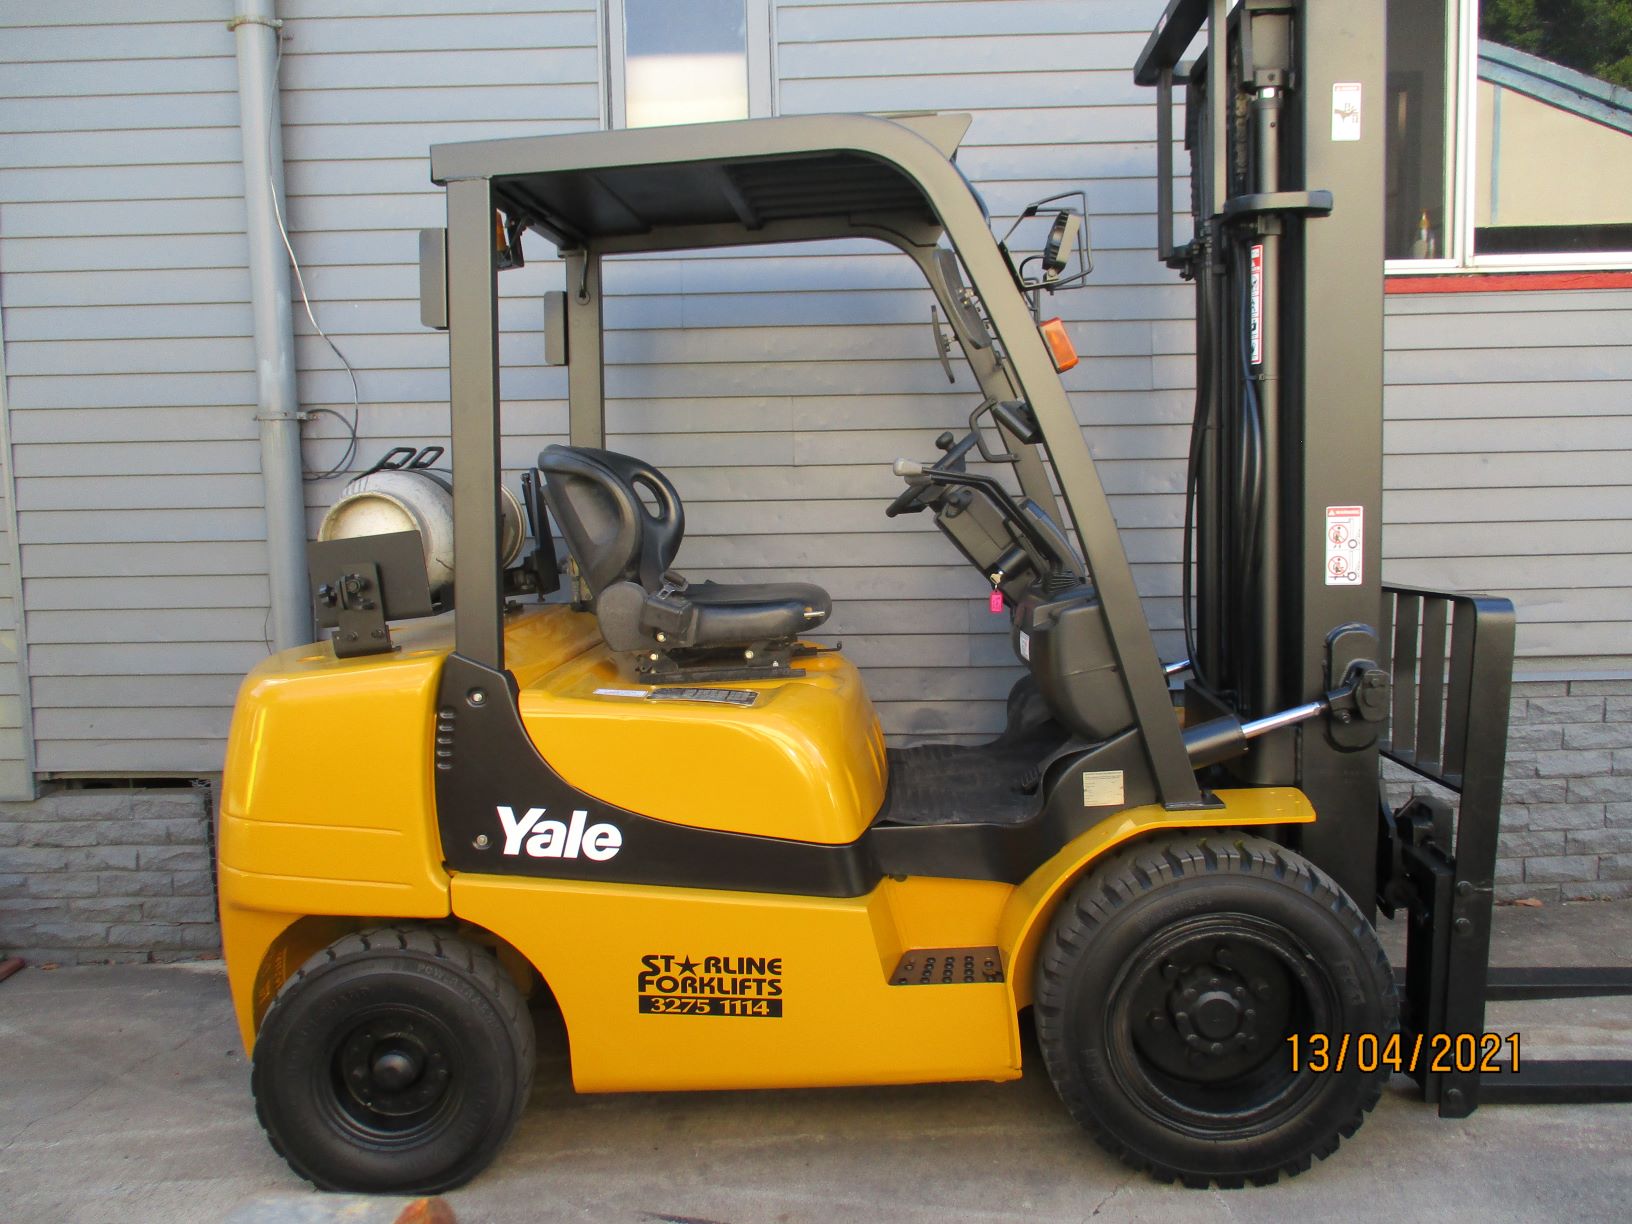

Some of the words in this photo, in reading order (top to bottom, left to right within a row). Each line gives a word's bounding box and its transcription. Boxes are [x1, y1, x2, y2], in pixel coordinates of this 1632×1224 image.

[496, 806, 622, 861] Yale
[638, 972, 783, 996] FORKLIFTS
[650, 998, 711, 1014] 3275
[720, 999, 770, 1016] 1114
